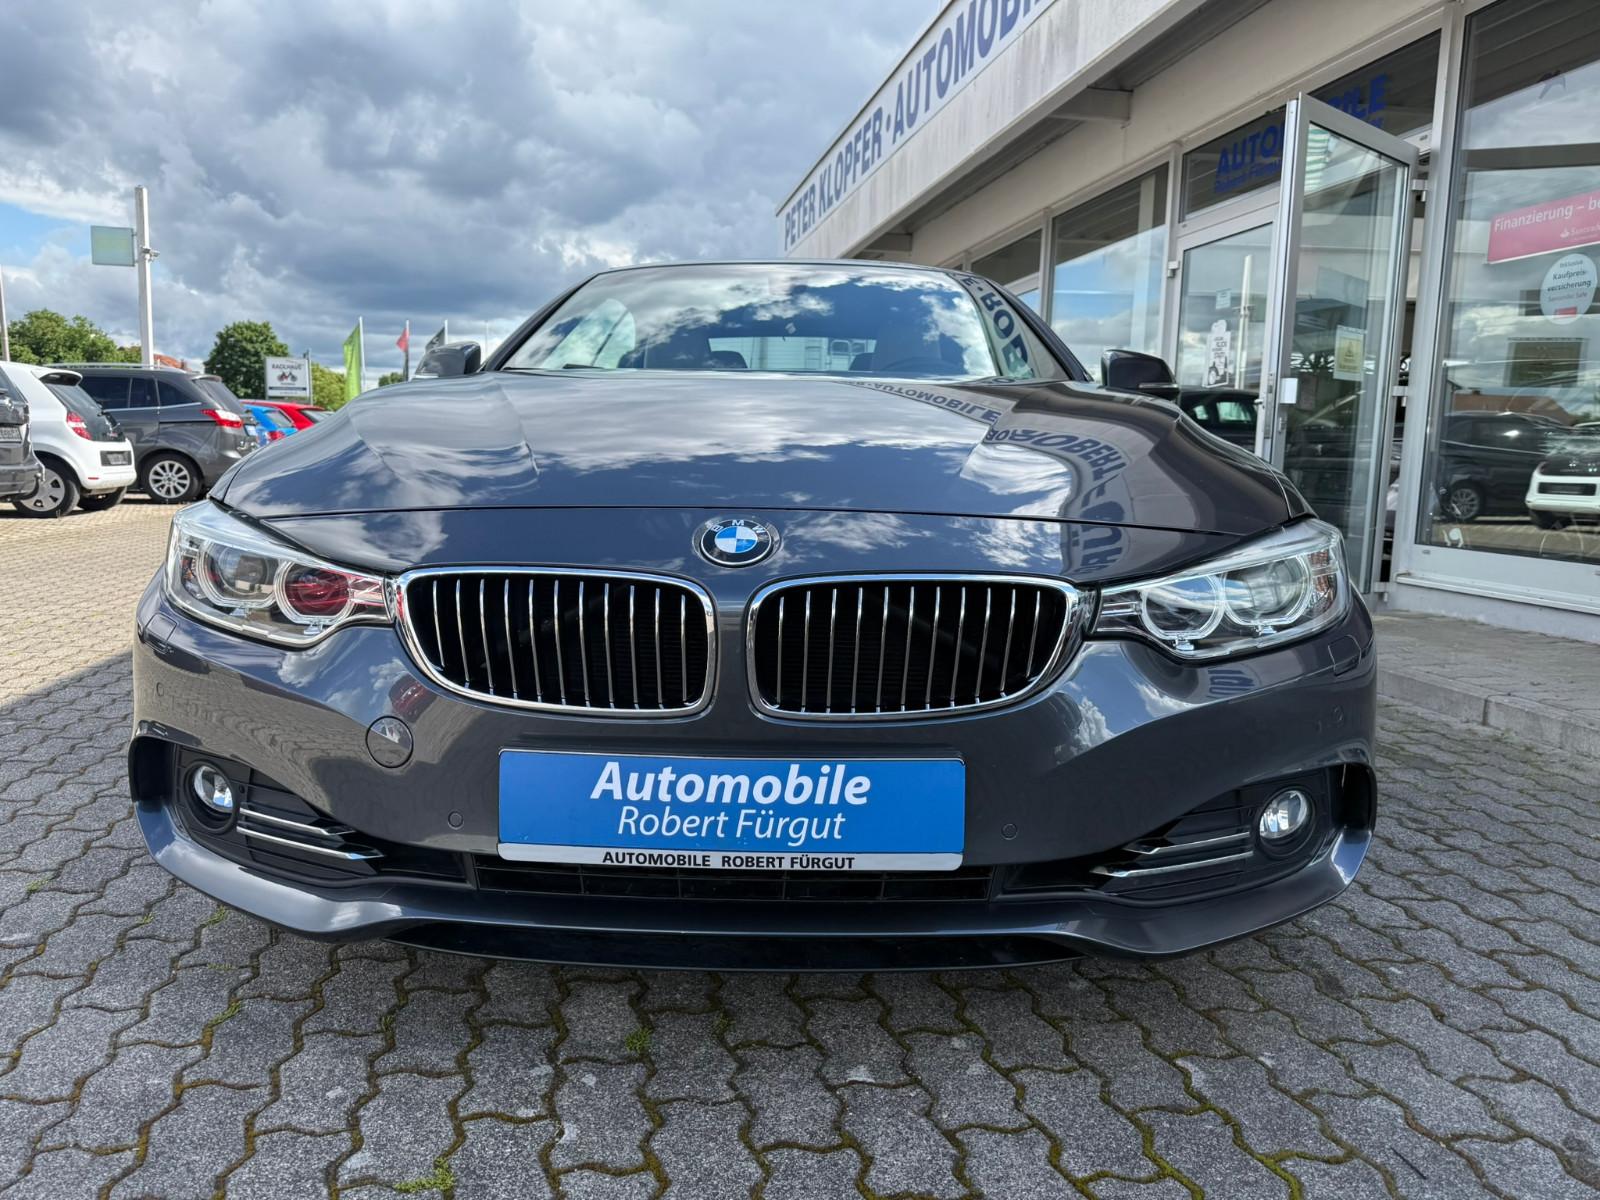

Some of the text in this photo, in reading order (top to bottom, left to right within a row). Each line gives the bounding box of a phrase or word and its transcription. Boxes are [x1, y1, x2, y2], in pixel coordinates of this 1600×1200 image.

[784, 183, 815, 251] PETER
[819, 106, 882, 217] KLOPFER
[1494, 205, 1574, 232] Finanzierung
[590, 761, 871, 805] Automobile
[618, 806, 846, 847] Robert Fürgut
[602, 851, 855, 869] AUTOMOBILE ROBERT FÜRGUT
